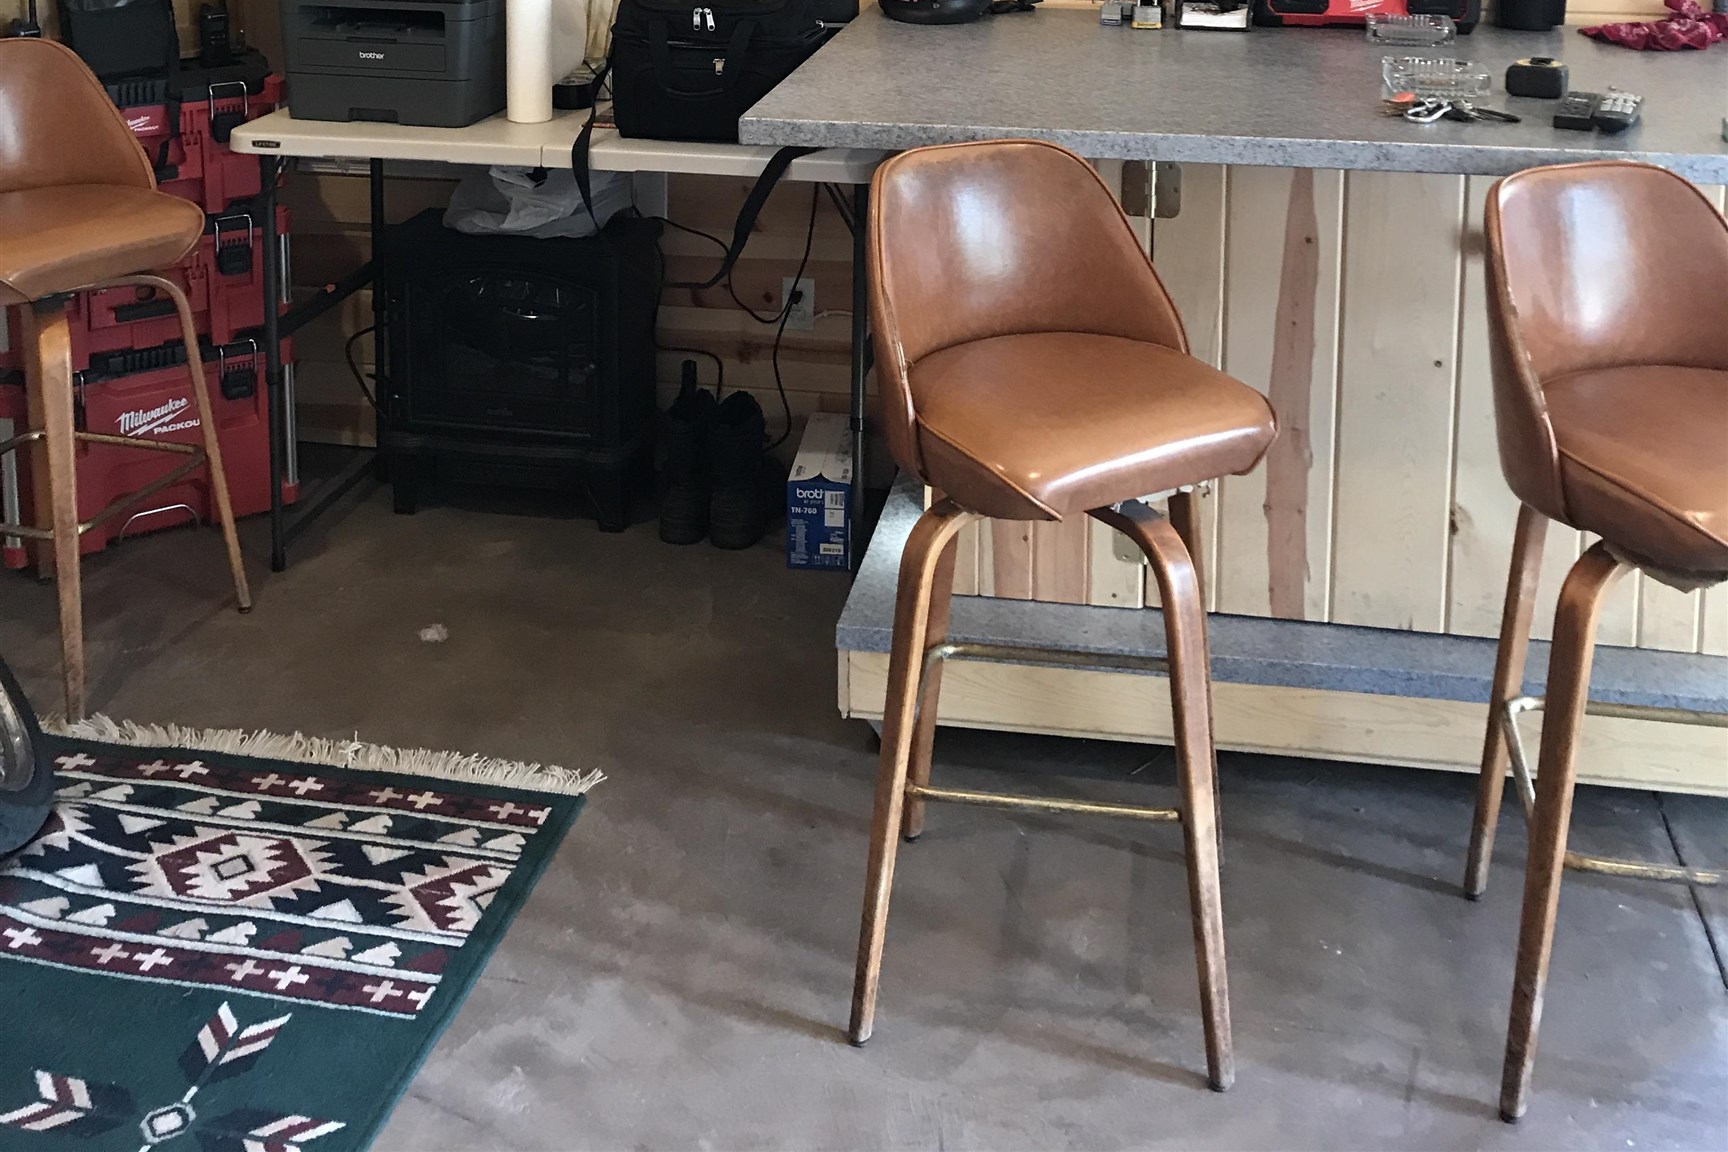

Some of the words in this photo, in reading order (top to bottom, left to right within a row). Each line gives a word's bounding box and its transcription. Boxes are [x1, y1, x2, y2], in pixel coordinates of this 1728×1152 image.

[359, 51, 385, 60] brother
[114, 397, 188, 435] Milwaukee
[153, 418, 200, 434] PACKOU
